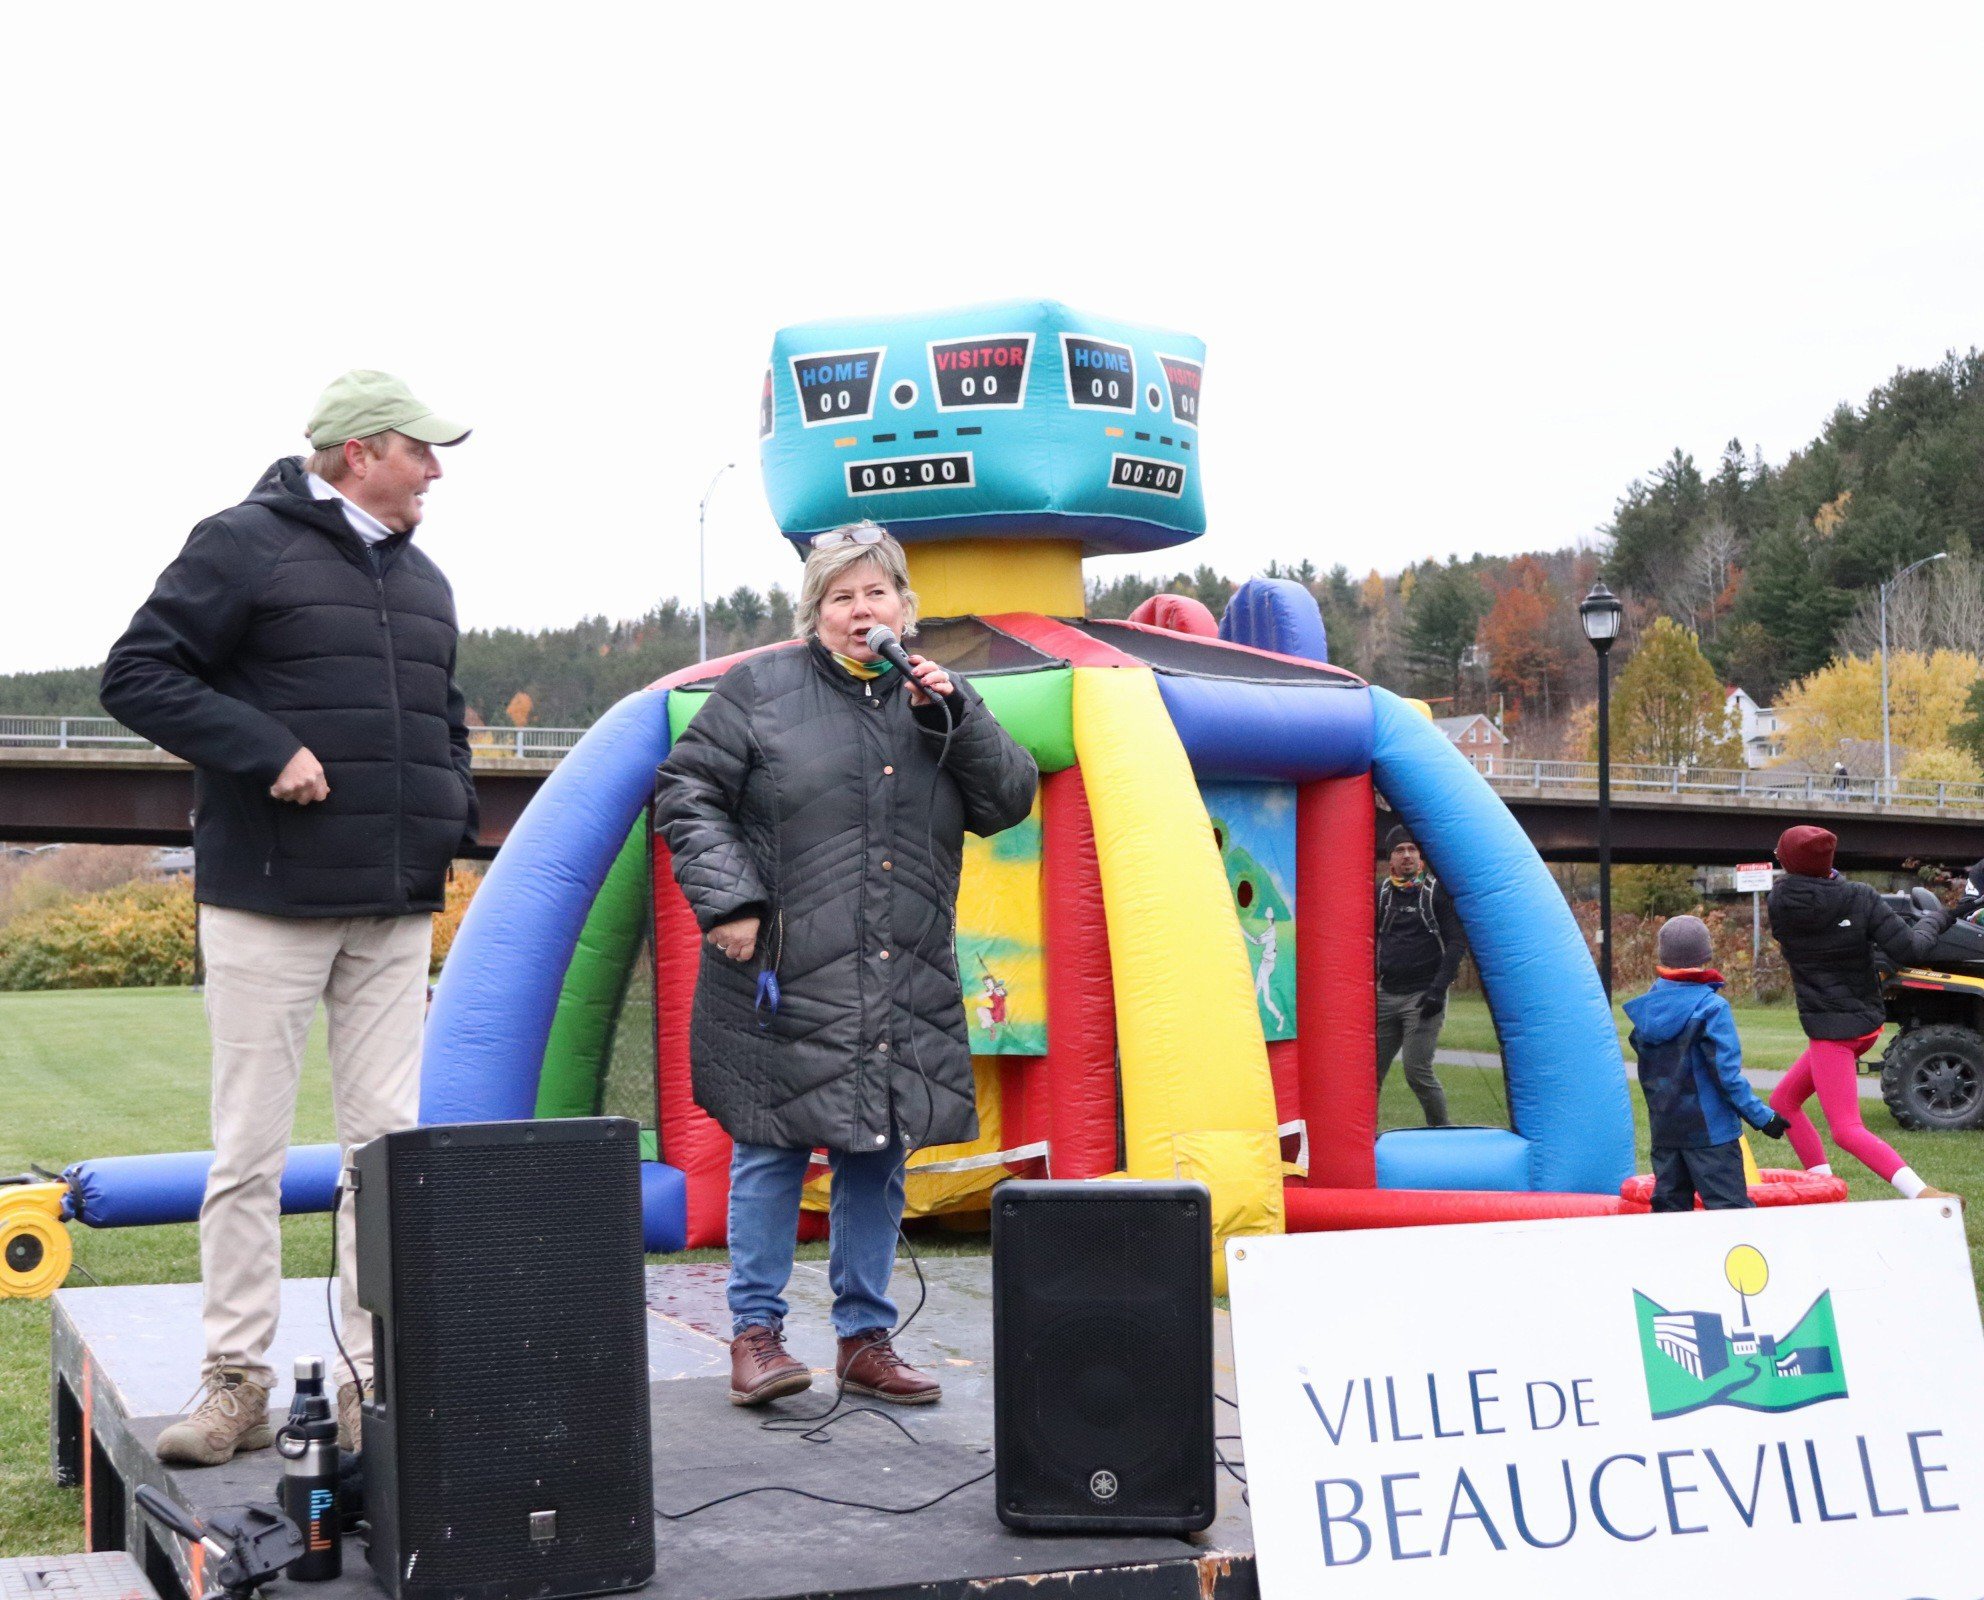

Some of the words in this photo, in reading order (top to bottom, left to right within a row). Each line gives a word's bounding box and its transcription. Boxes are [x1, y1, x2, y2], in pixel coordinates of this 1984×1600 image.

[936, 347, 1025, 370] VISITOR
[1075, 348, 1130, 374] HOME
[802, 359, 869, 387] HOME
[961, 376, 998, 397] 00
[1091, 378, 1119, 400] 00
[820, 390, 851, 412] 00
[1182, 394, 1195, 415] 00
[861, 461, 957, 488] 00:00
[1120, 461, 1177, 489] 00:00
[1302, 1369, 1506, 1446] VILLE
[1525, 1378, 1600, 1431] DE
[1315, 1430, 1960, 1567] BEAUCEVILLE
